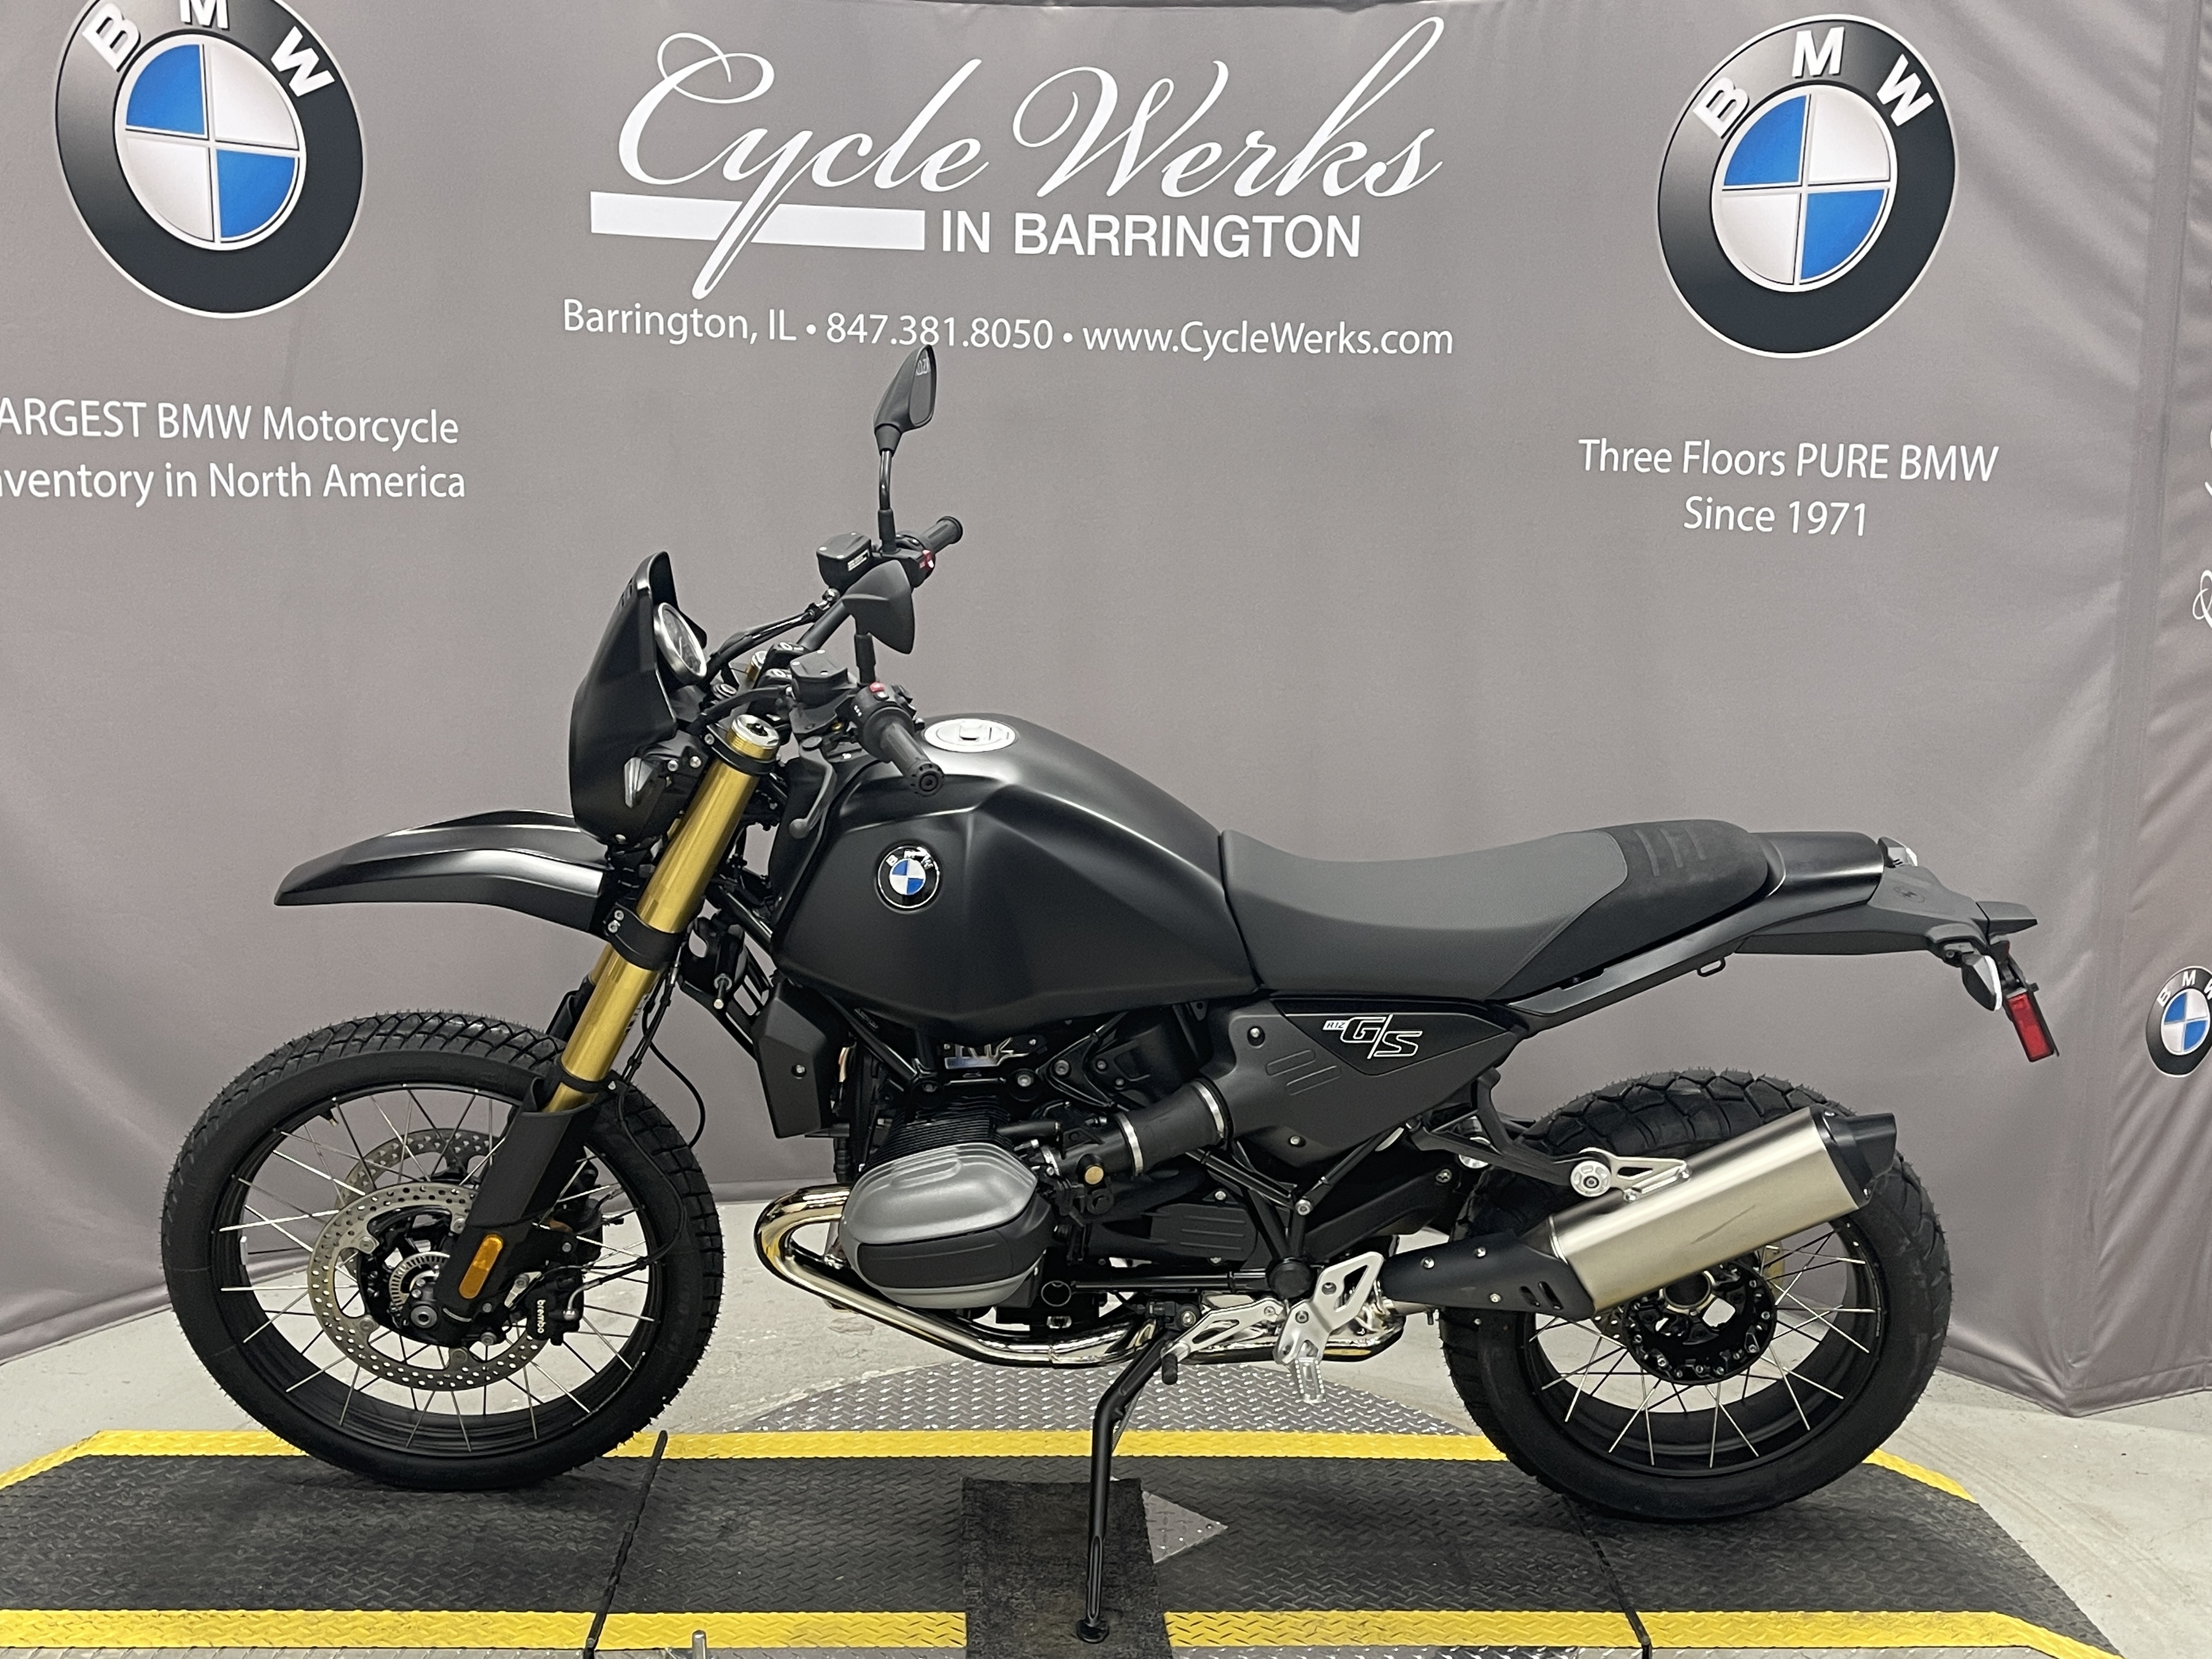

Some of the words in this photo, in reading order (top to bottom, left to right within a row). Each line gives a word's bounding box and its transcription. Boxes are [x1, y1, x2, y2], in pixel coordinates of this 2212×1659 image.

[1692, 26, 1934, 139] BMW
[619, 32, 989, 300] Cycle
[1013, 16, 1444, 198] Werks
[943, 210, 990, 253] IN
[1015, 212, 1361, 258] BARRINGTON
[564, 298, 757, 345] Barrington,
[770, 309, 797, 341] IL
[827, 312, 1053, 349] 847.381.8050
[1082, 320, 1453, 362] www.CycleWerks.com
[158, 403, 252, 439] BMW
[264, 406, 459, 452] Motorcycle
[1578, 438, 1672, 473] Three
[1683, 439, 1786, 476] Floors
[1797, 443, 1889, 479] PURE
[1900, 444, 1999, 482] BMW
[0, 464, 154, 508] ventory
[165, 462, 197, 497] in
[210, 461, 311, 497] North
[323, 464, 465, 498] America
[1684, 495, 1775, 532] Since
[1789, 501, 1865, 537] 1971
[885, 850, 934, 870] BMW
[537, 1299, 546, 1334] brembo
